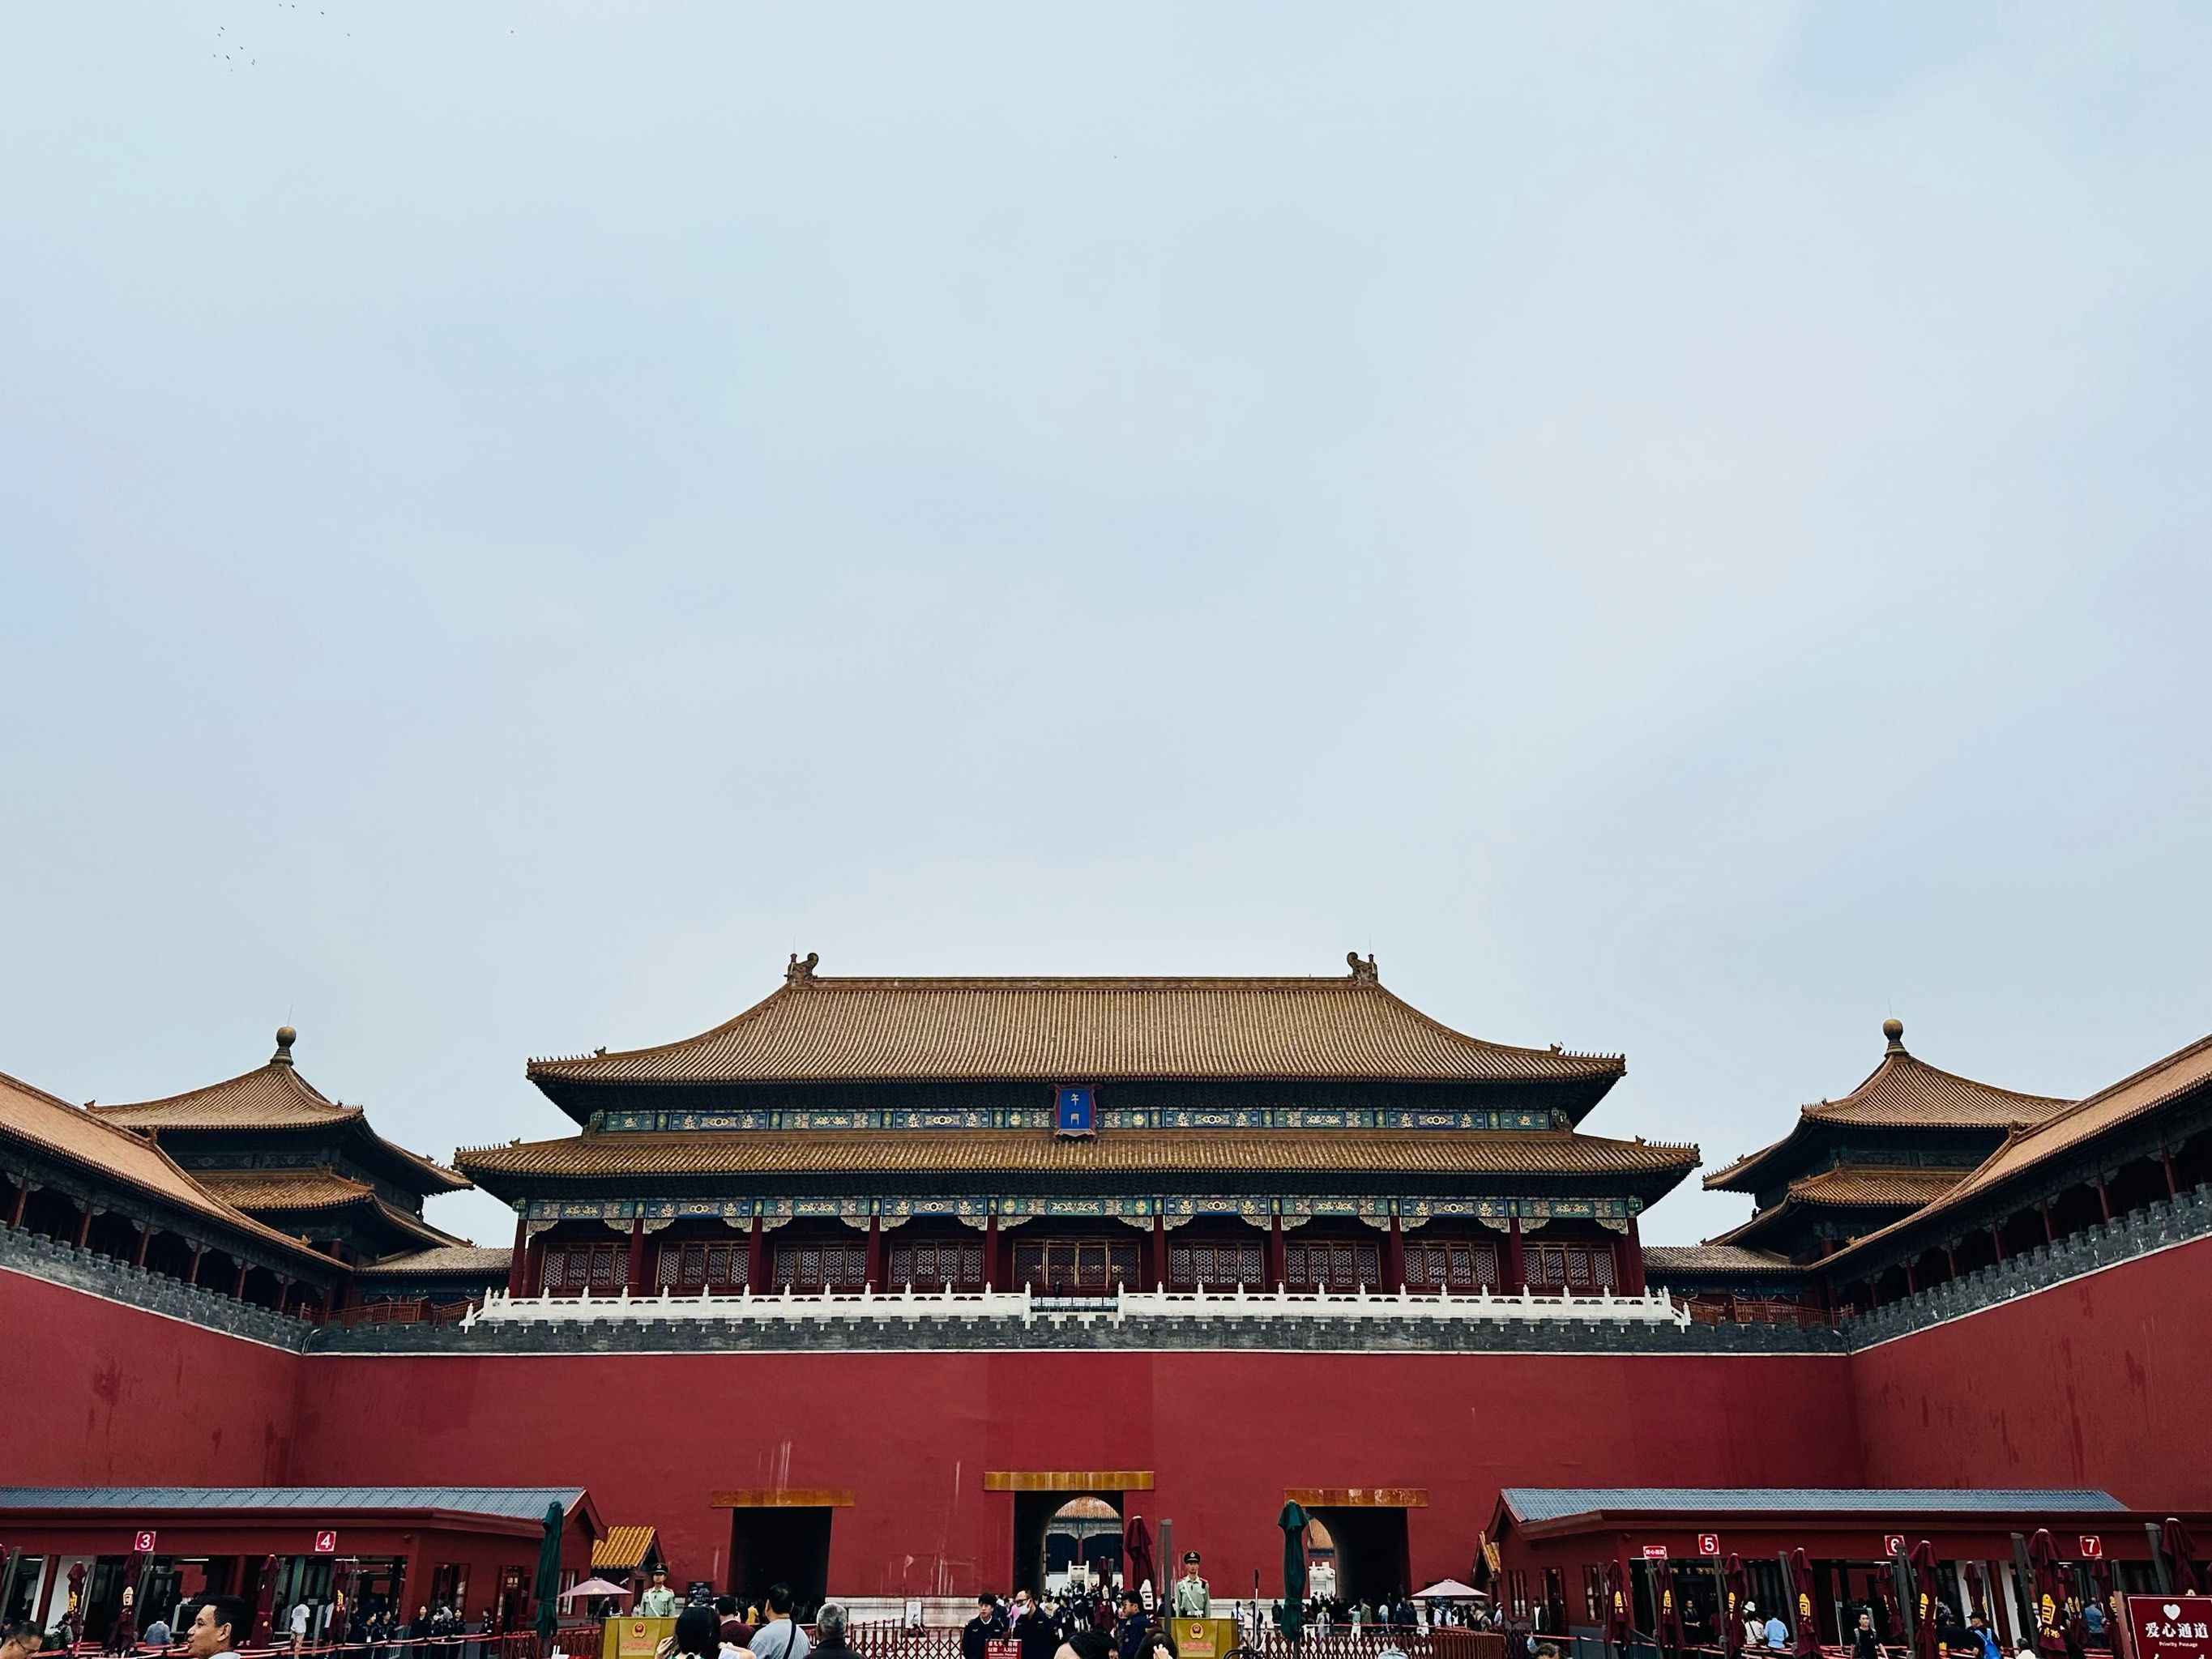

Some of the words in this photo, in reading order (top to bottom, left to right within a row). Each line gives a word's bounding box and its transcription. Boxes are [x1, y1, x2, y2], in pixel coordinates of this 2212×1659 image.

[140, 1533, 151, 1548] 3
[320, 1533, 331, 1548] 4
[1704, 1537, 1715, 1551] 5
[2085, 1538, 2095, 1553] 7
[2145, 1622, 2209, 1639] 爱心通道
